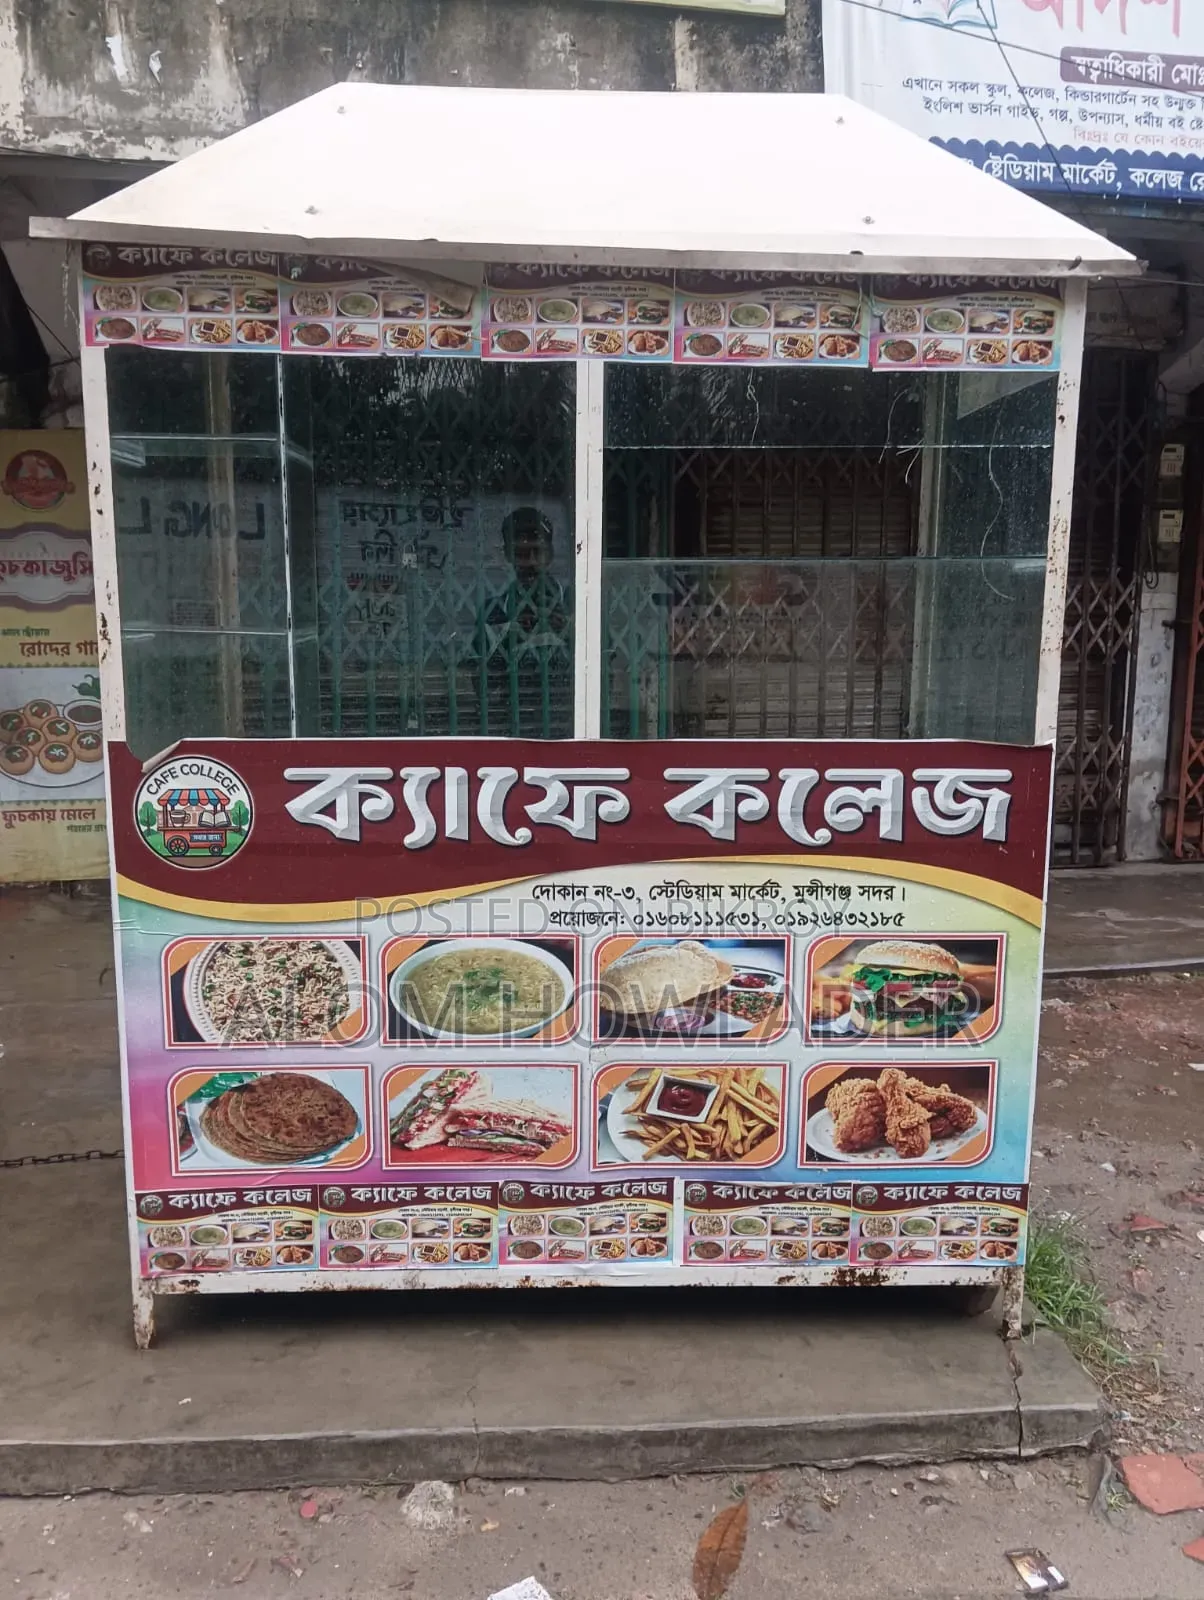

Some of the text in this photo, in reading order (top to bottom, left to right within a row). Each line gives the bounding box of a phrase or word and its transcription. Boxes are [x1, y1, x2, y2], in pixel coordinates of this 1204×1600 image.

[902, 77, 942, 91] এখানে
[948, 80, 980, 95] সকল
[1141, 94, 1160, 108] সহ
[922, 95, 963, 114] ইংলিশ
[1128, 167, 1185, 191] কলেজ
[117, 246, 278, 268] ক্যাফে কলেজ
[19, 639, 71, 658] রোদের
[146, 763, 240, 796] CAFE COLLEGE
[2, 807, 96, 830] ফুচকায় মেলে
[283, 766, 1013, 849] ক্যাফে কলেজ
[532, 883, 589, 902] দোকান
[594, 884, 641, 904] নং-৩,
[648, 879, 724, 902] স্টেডিয়াম
[729, 879, 787, 904] মার্কেট,
[633, 911, 767, 930] ০১৬০৮১১১৫৩১,
[774, 911, 905, 928] ০১৯২৬৪৩২১৮৫
[168, 1186, 313, 1210] ক্যাফে কলেজ
[350, 1185, 493, 1205] ক্যাফে কলেজ
[529, 1179, 669, 1202] ক্যাফে কলেজ
[712, 1183, 851, 1203] ক্যাফে কলেজ
[883, 1184, 1022, 1203] ক্যাফে কলেজ
